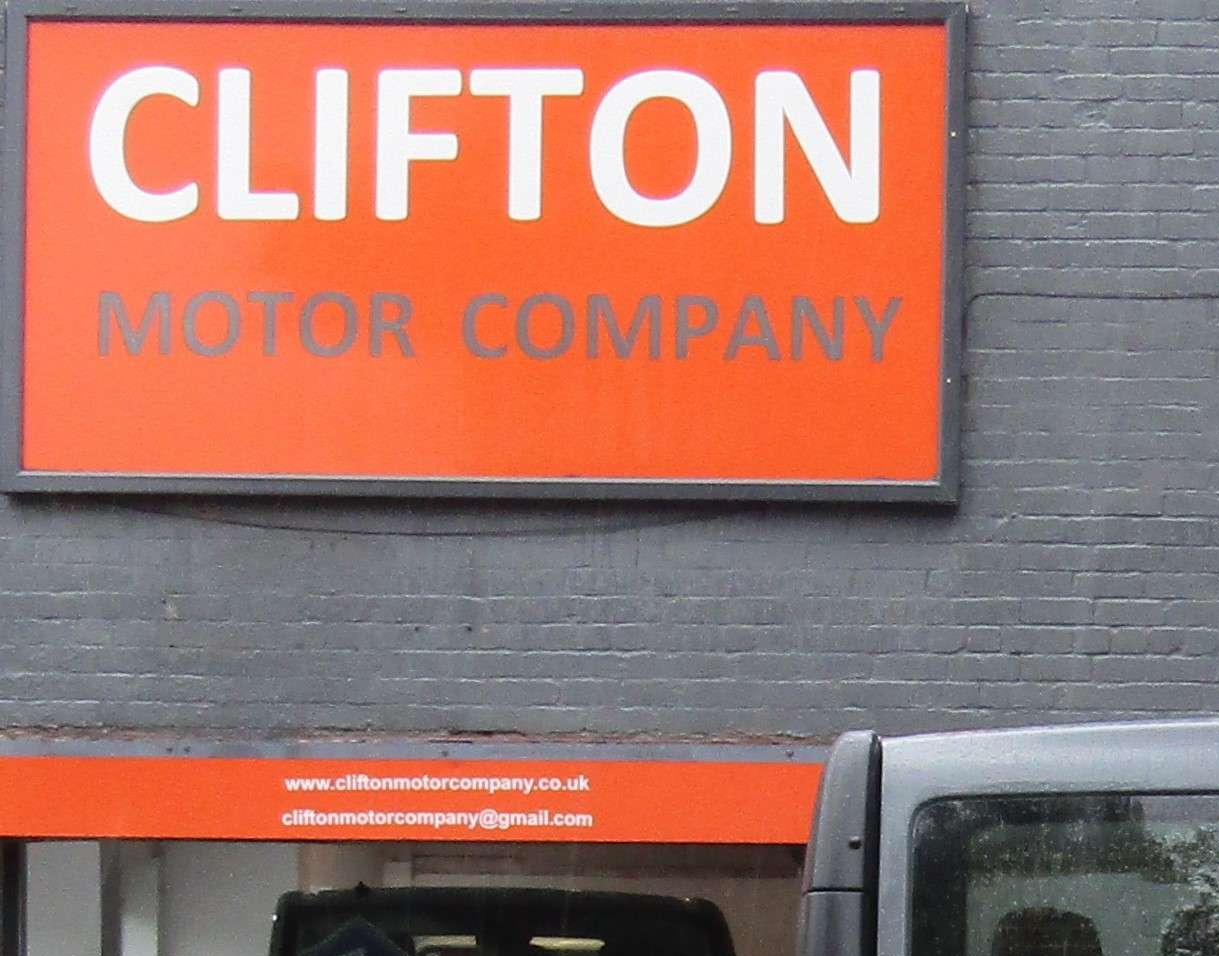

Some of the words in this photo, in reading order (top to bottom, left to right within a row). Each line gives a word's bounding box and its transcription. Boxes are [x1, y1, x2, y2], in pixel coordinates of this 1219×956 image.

[88, 67, 881, 227] CLIFTON
[96, 291, 415, 361] MOTOR
[461, 293, 903, 363] COMPANY
[285, 774, 590, 792] www.cliftonmotorcompany.co.uk
[281, 809, 593, 829] cliftonmotorcompany@gmail.com
